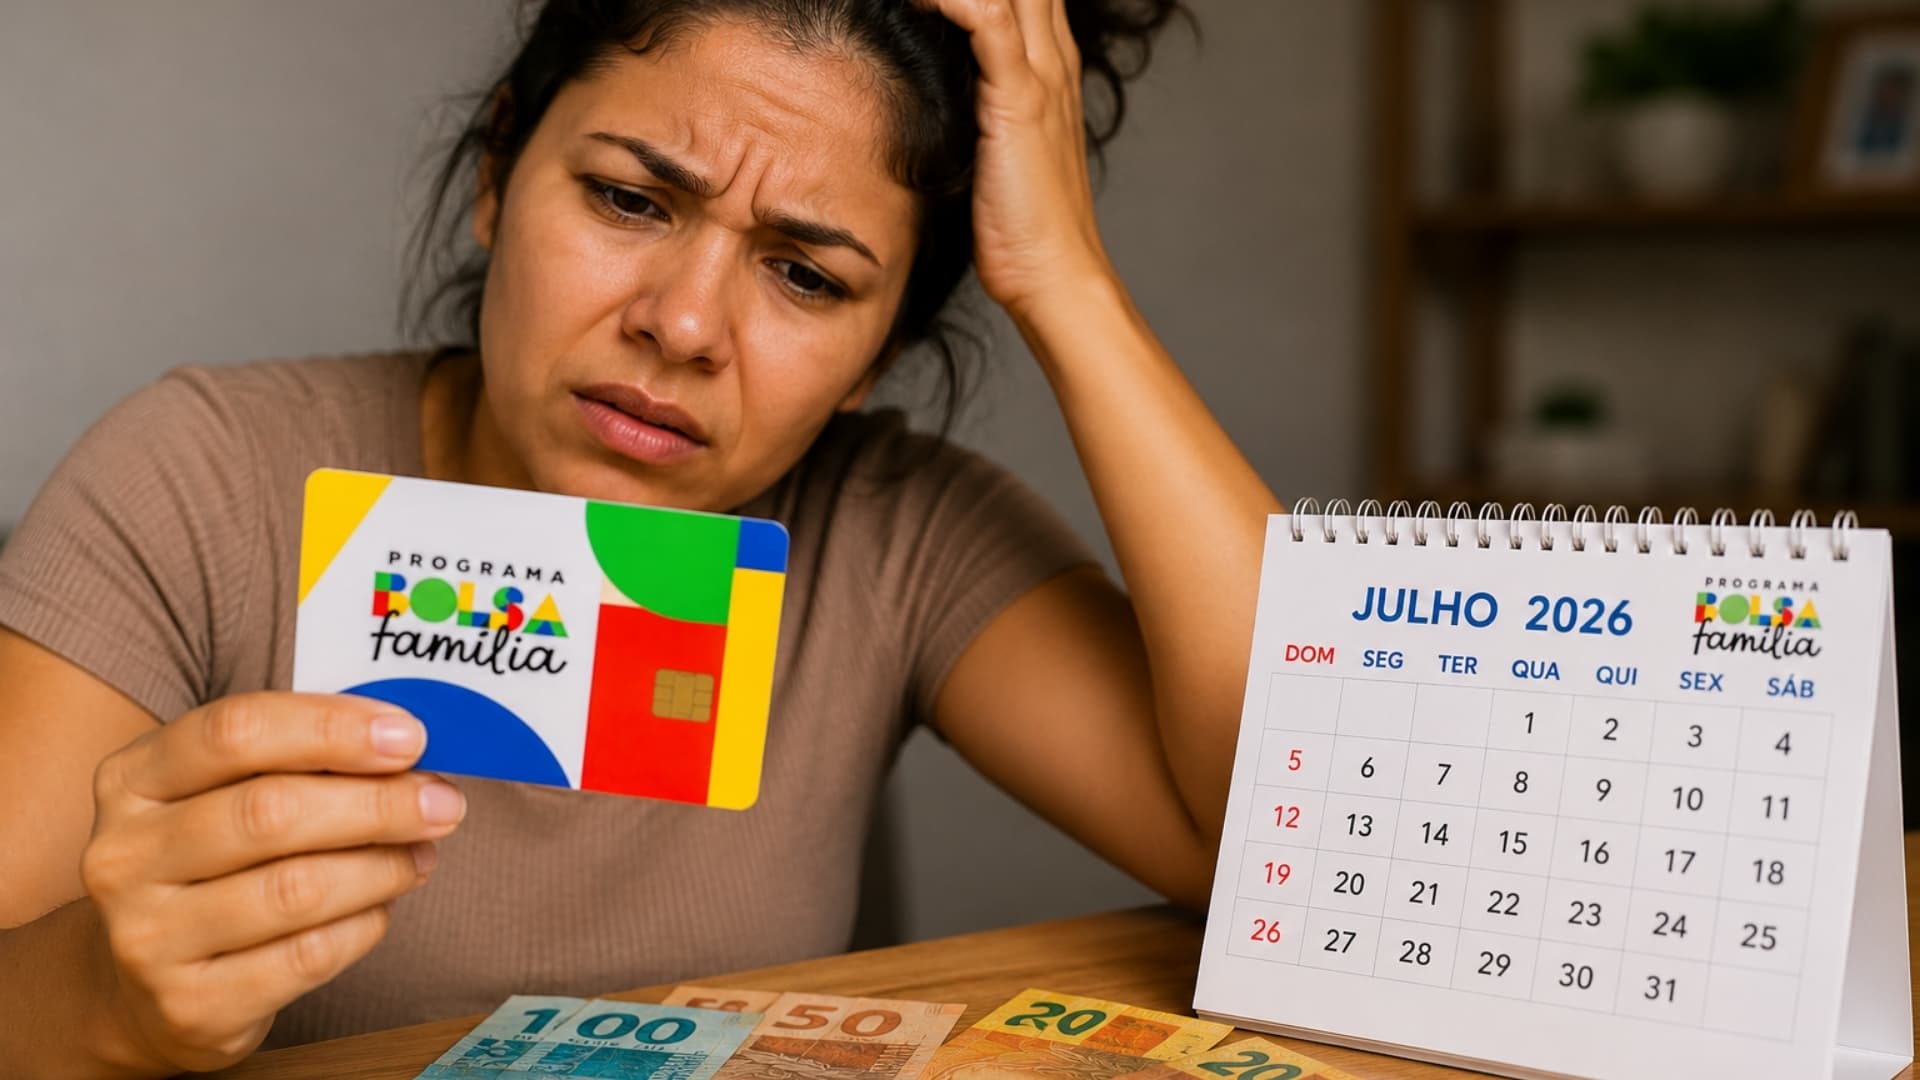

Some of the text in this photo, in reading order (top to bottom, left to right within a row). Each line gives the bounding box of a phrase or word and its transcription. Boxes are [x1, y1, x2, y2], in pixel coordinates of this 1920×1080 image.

[388, 551, 565, 584] PROGRAMA
[1704, 576, 1819, 592] PROGRAMA
[371, 571, 569, 638] BOLSA
[1351, 586, 1633, 637] JULHO 2026
[1694, 591, 1822, 629] BOLSA
[1284, 644, 1815, 699] DOM SEG TER QUA QUI SEX SÁB
[1524, 711, 1791, 756] 1 2 3 4
[1287, 749, 1790, 821] 5 6 7 8 9 10 11
[1274, 805, 1785, 886] 12 13 14 15 16 17 18
[1264, 861, 1777, 951] 19 20 21 22 23 24 25
[1250, 918, 1676, 1003] 26 27 28 29 30 31
[521, 1008, 697, 1045] 100
[771, 1003, 903, 1038] 50
[1003, 1001, 1107, 1036] 20
[1197, 1050, 1303, 1080] 20
